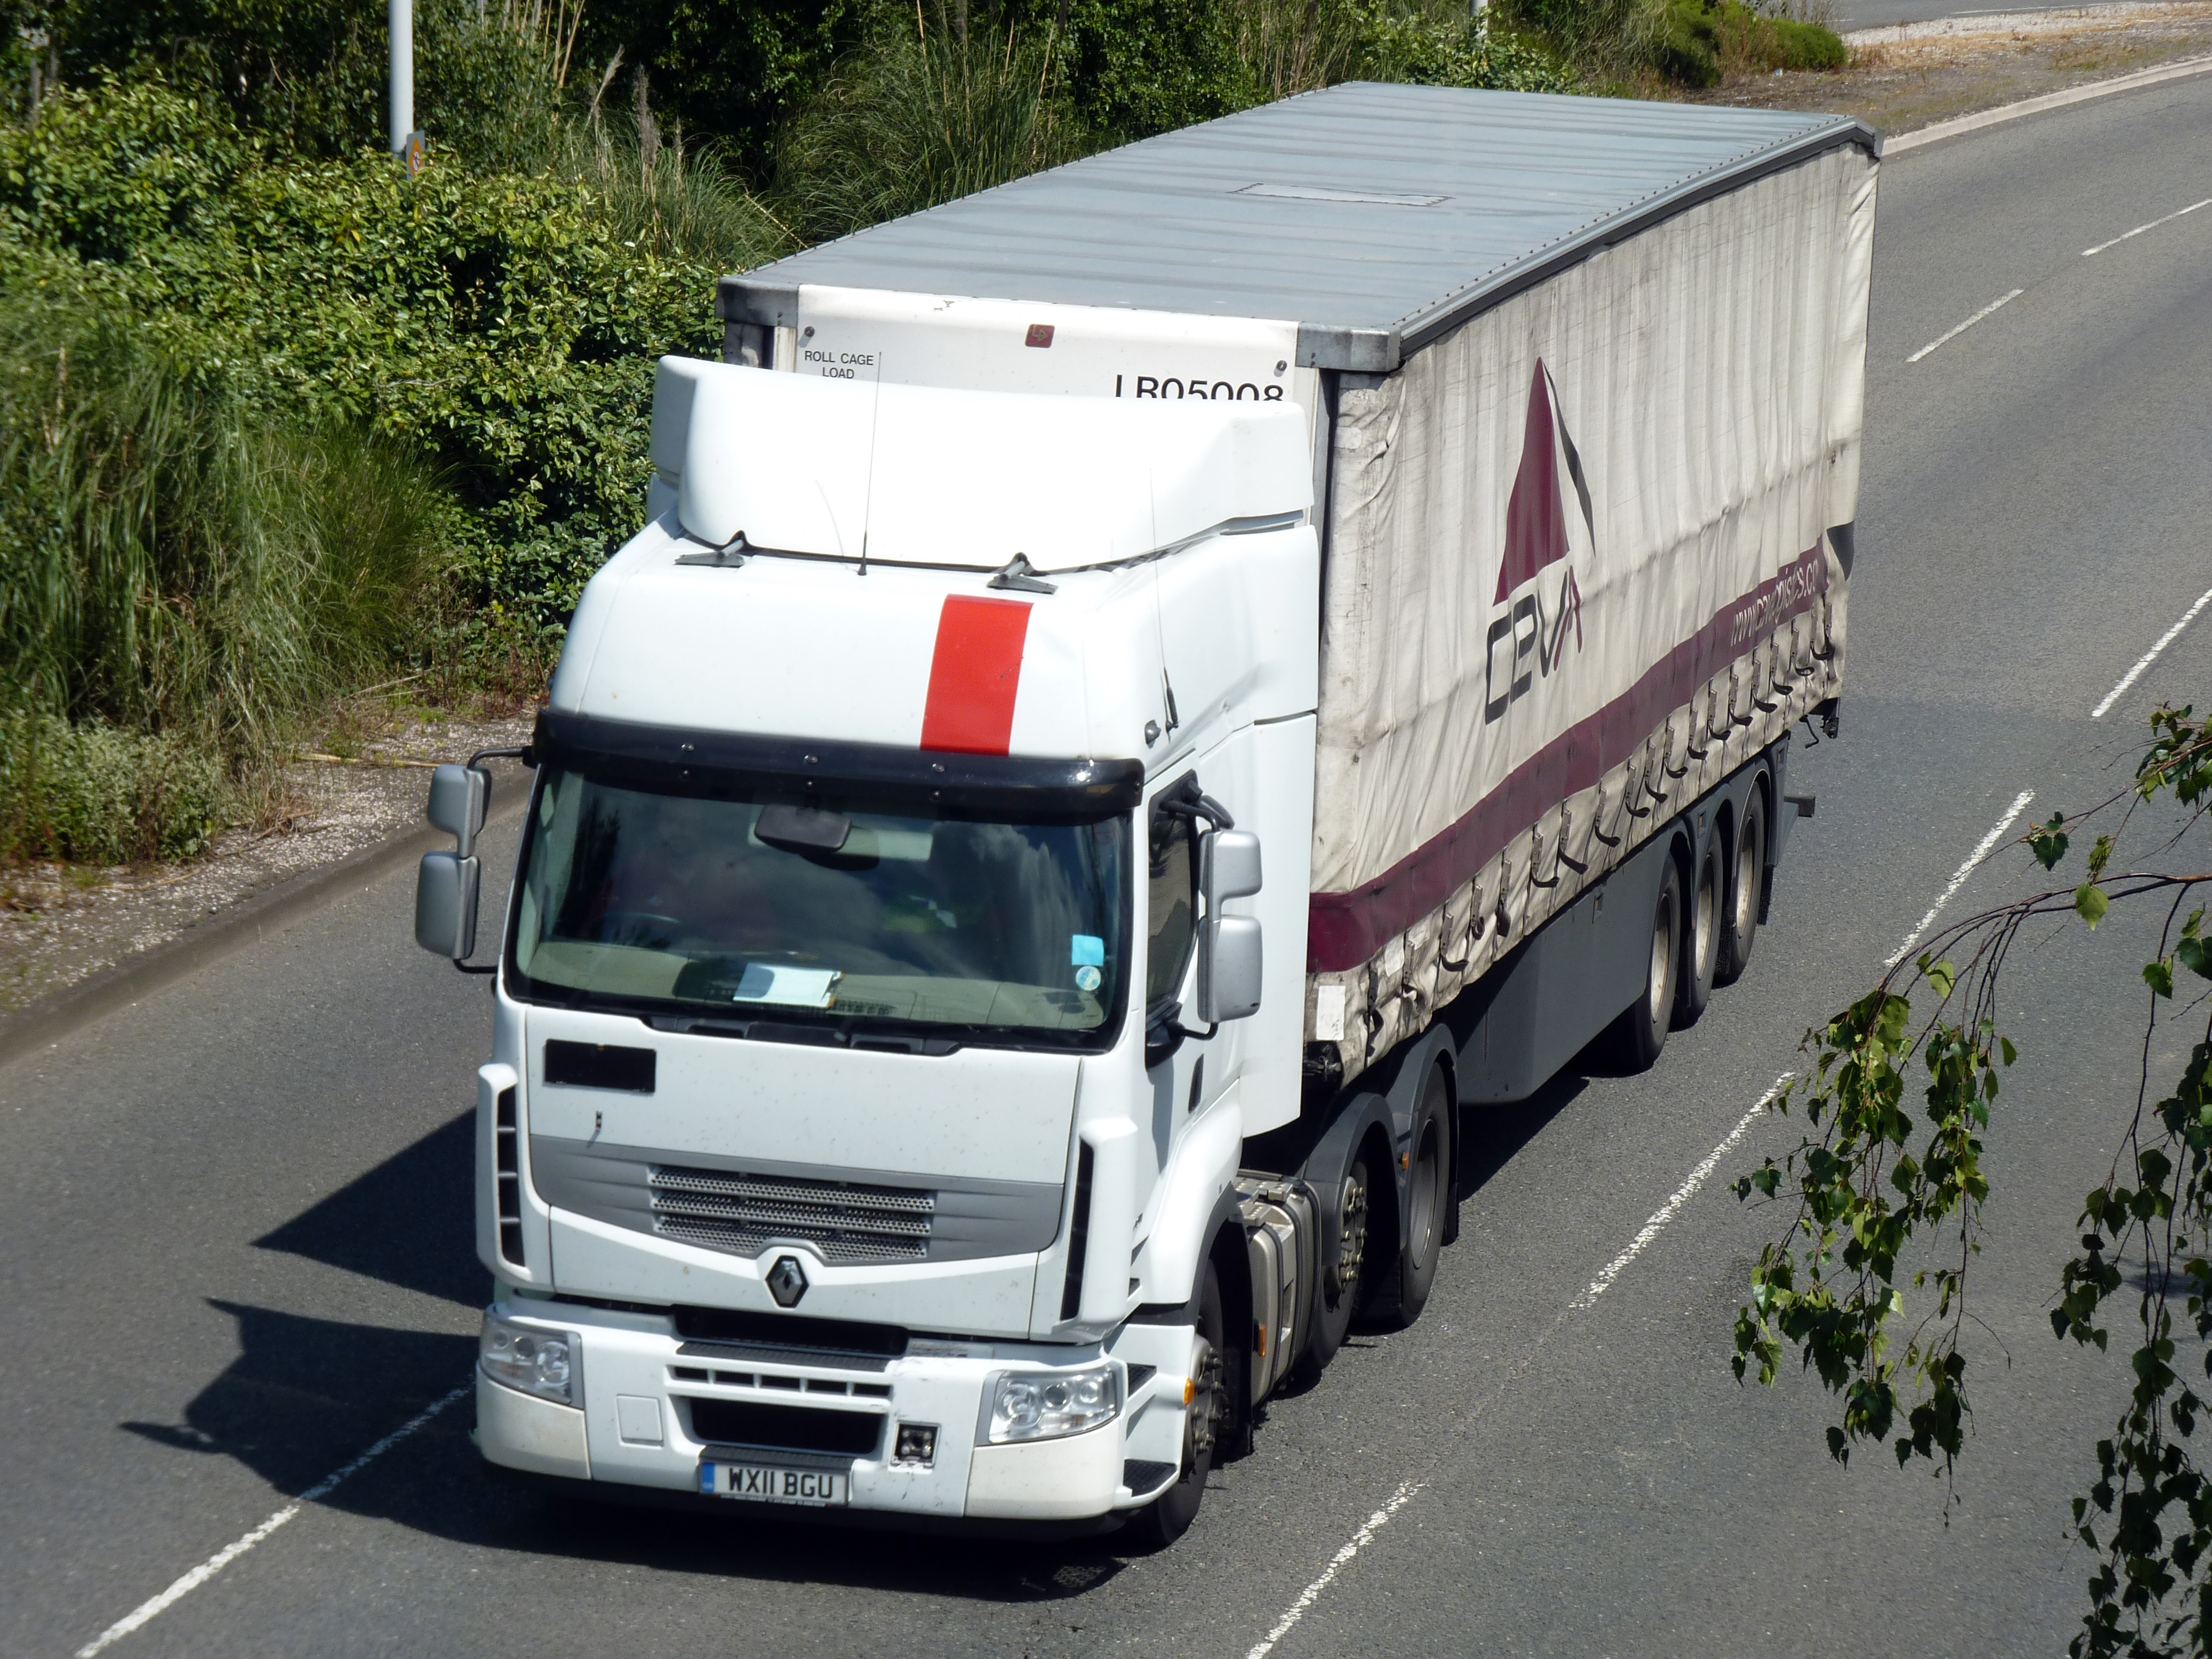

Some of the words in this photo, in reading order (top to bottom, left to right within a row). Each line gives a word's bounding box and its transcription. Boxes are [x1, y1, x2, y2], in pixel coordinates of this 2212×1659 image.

[805, 351, 836, 363] ROLL
[841, 353, 874, 366] CAGE
[822, 367, 855, 379] LOAD
[729, 1468, 774, 1494] WX11
[783, 1471, 833, 1499] BGU
